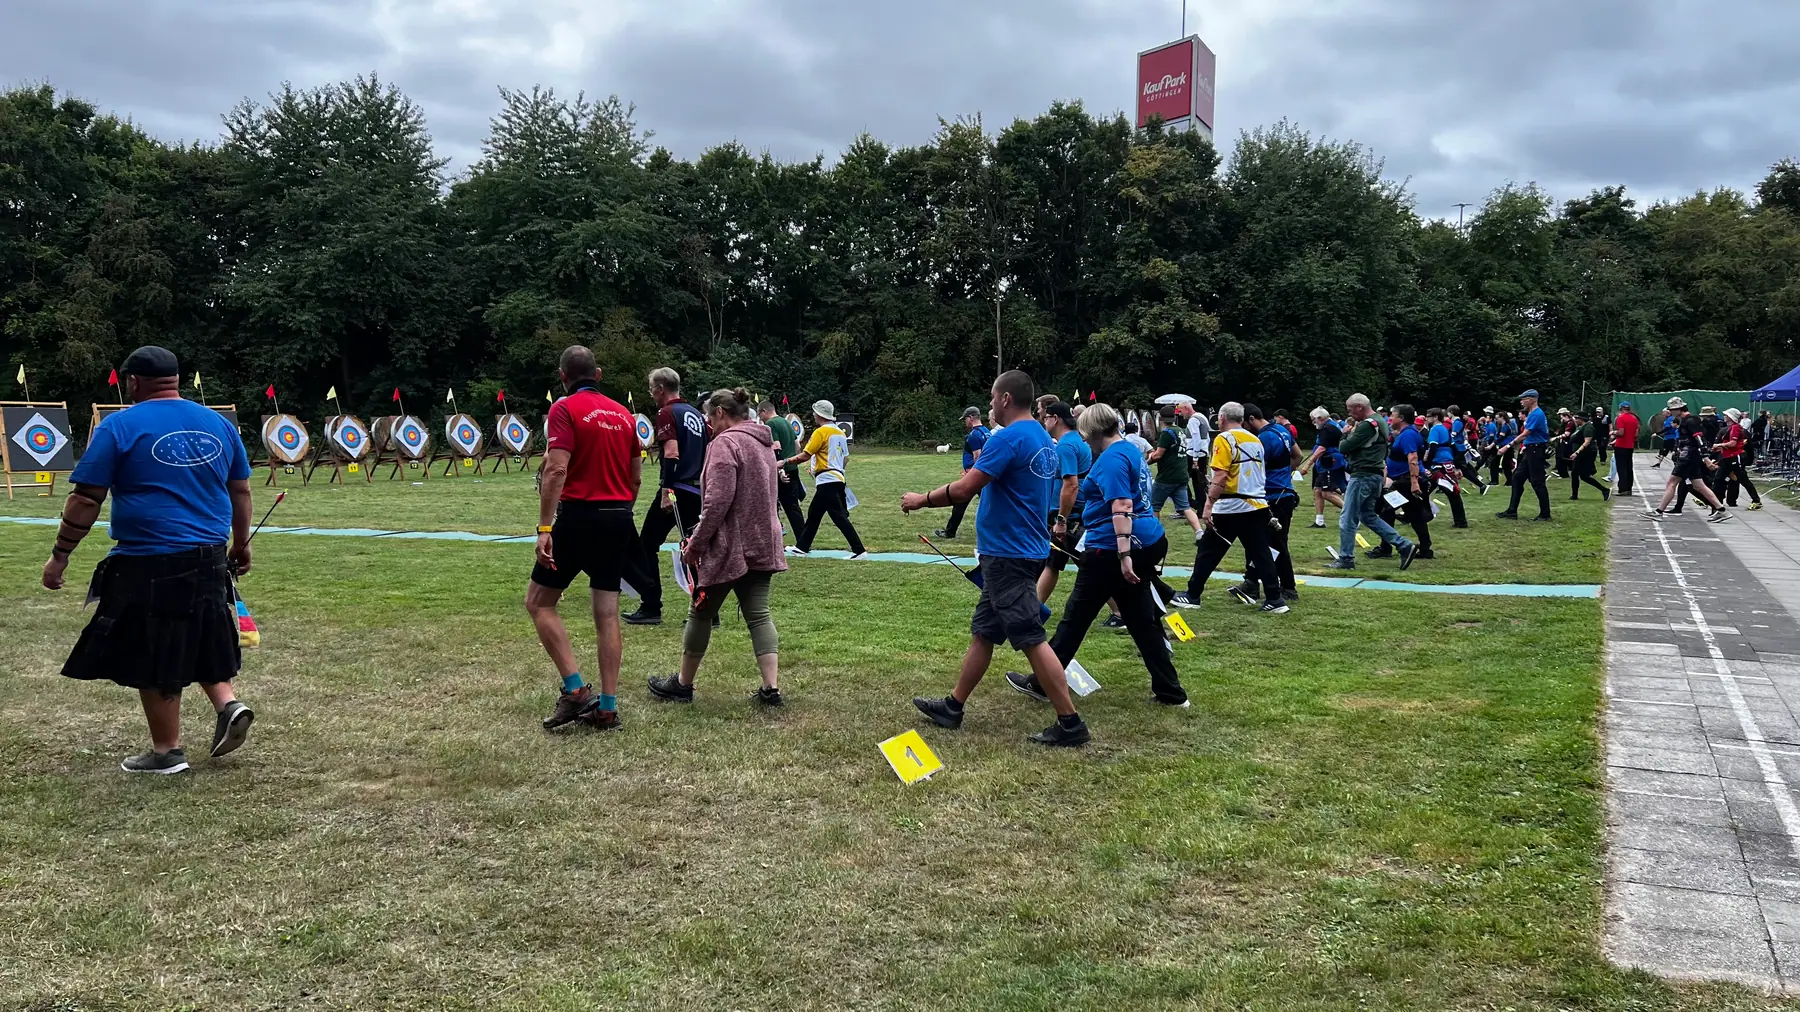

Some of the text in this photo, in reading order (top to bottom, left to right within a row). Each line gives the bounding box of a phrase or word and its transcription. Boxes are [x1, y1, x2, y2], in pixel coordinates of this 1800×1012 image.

[1146, 87, 1182, 103] GÖTTINGEN
[1070, 671, 1088, 689] 2
[905, 745, 924, 767] 1
